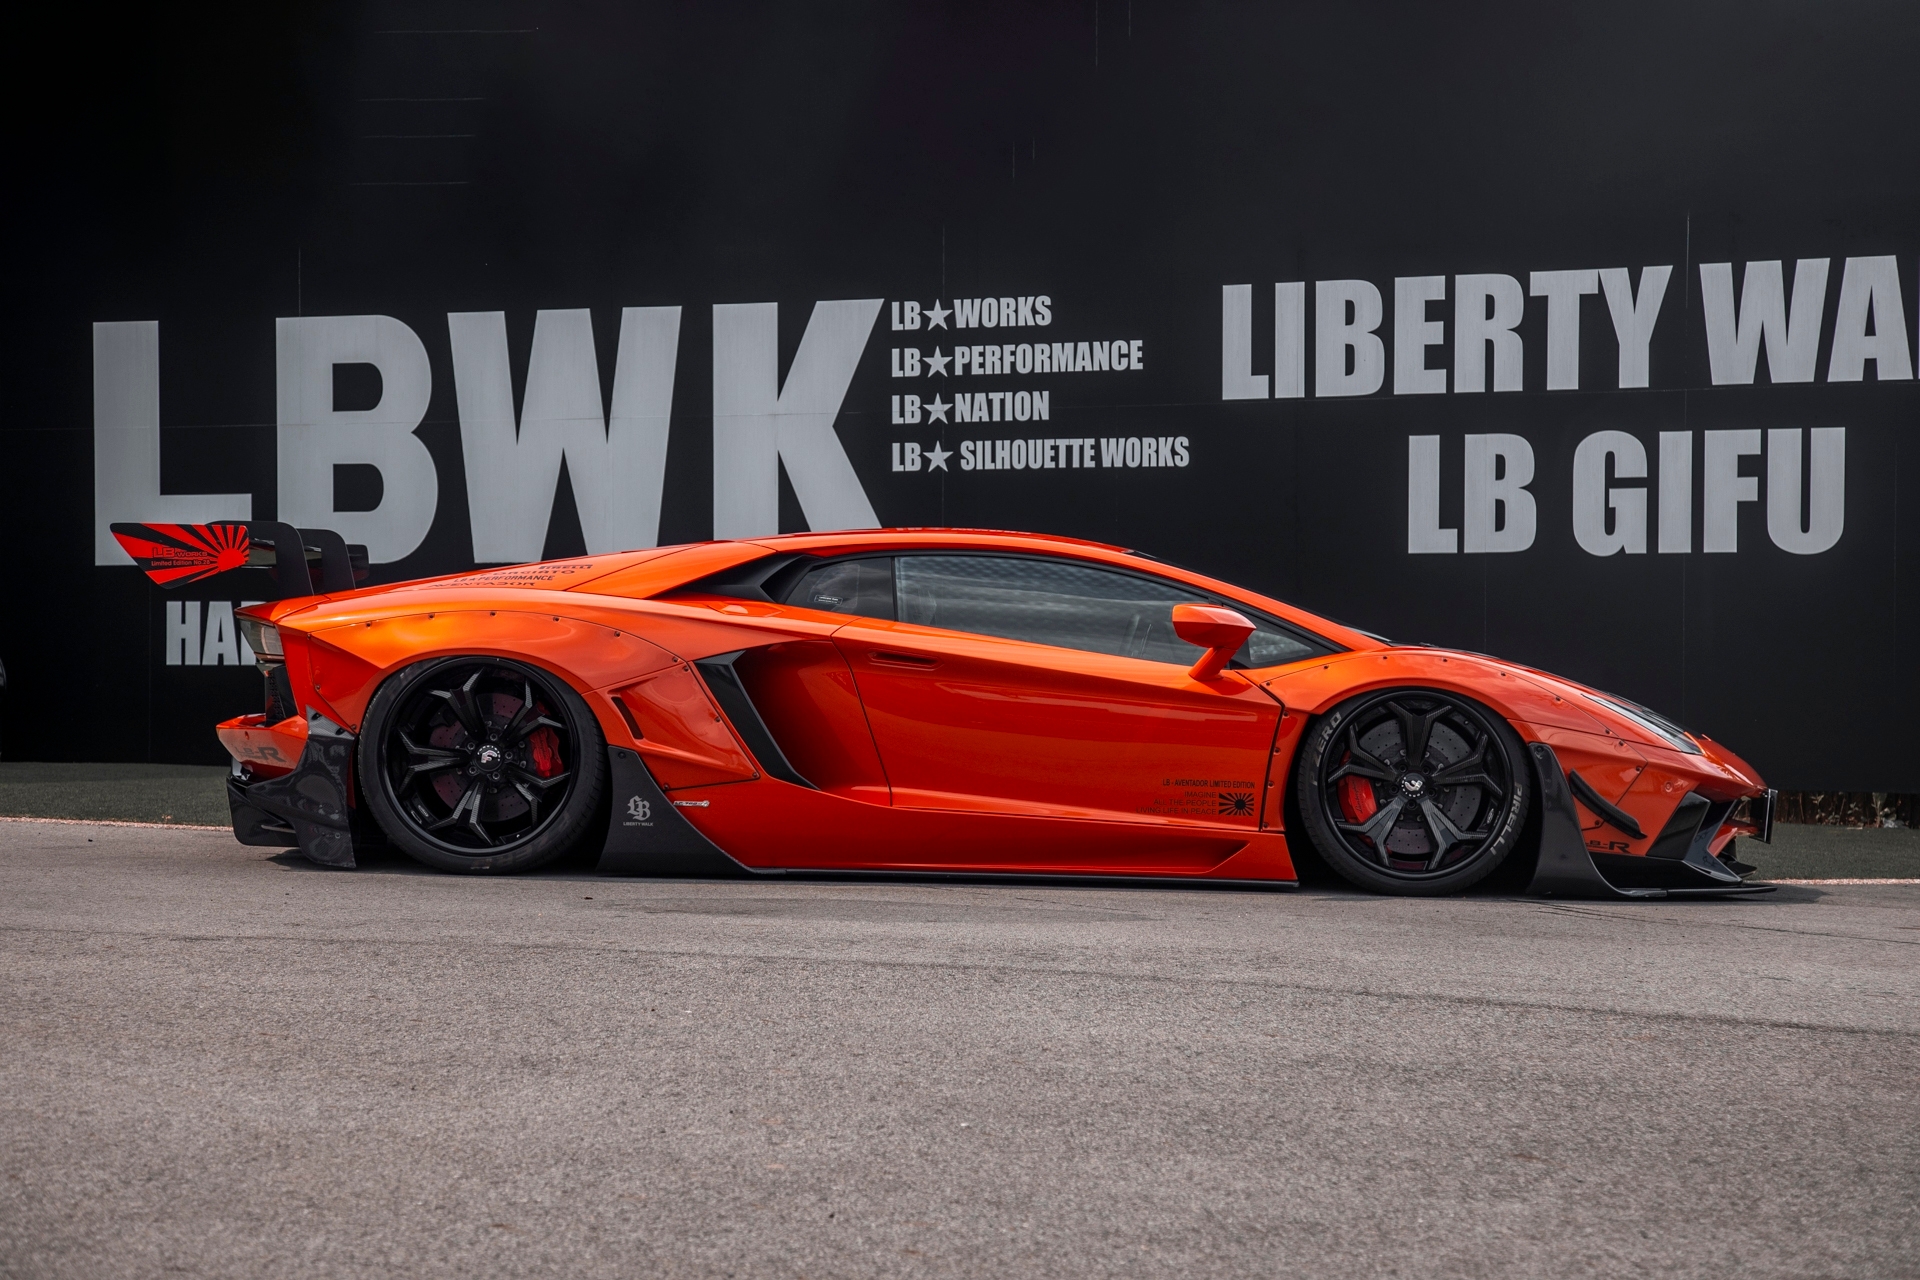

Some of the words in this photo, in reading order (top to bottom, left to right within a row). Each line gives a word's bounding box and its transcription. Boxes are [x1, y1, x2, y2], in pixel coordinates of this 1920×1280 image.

[892, 301, 921, 330] LB
[954, 295, 1052, 328] WORKS
[1222, 265, 1673, 400] LIBERTY
[1699, 255, 1920, 386] WA
[892, 348, 921, 377] LB
[955, 340, 1144, 375] PERFORMANCE
[892, 395, 921, 424] LB
[955, 391, 1049, 422] NATION
[93, 299, 885, 565] LBWK
[892, 442, 921, 472] LB
[961, 438, 1096, 470] SILHOUETTE
[1100, 436, 1190, 467] WORKS
[1408, 433, 1537, 555] LB
[1573, 427, 1846, 557] GIFU
[480, 574, 555, 582] PERFORMANCE
[1163, 779, 1171, 787] LB
[1174, 779, 1209, 788] AVENTADOR
[1209, 780, 1232, 788] LIMITED
[1233, 781, 1255, 789] EDITION
[1184, 791, 1217, 799] IMAGINE
[1136, 806, 1161, 814] LIVING
[1182, 807, 1189, 815] IN
[1186, 799, 1217, 807] PEOPLE
